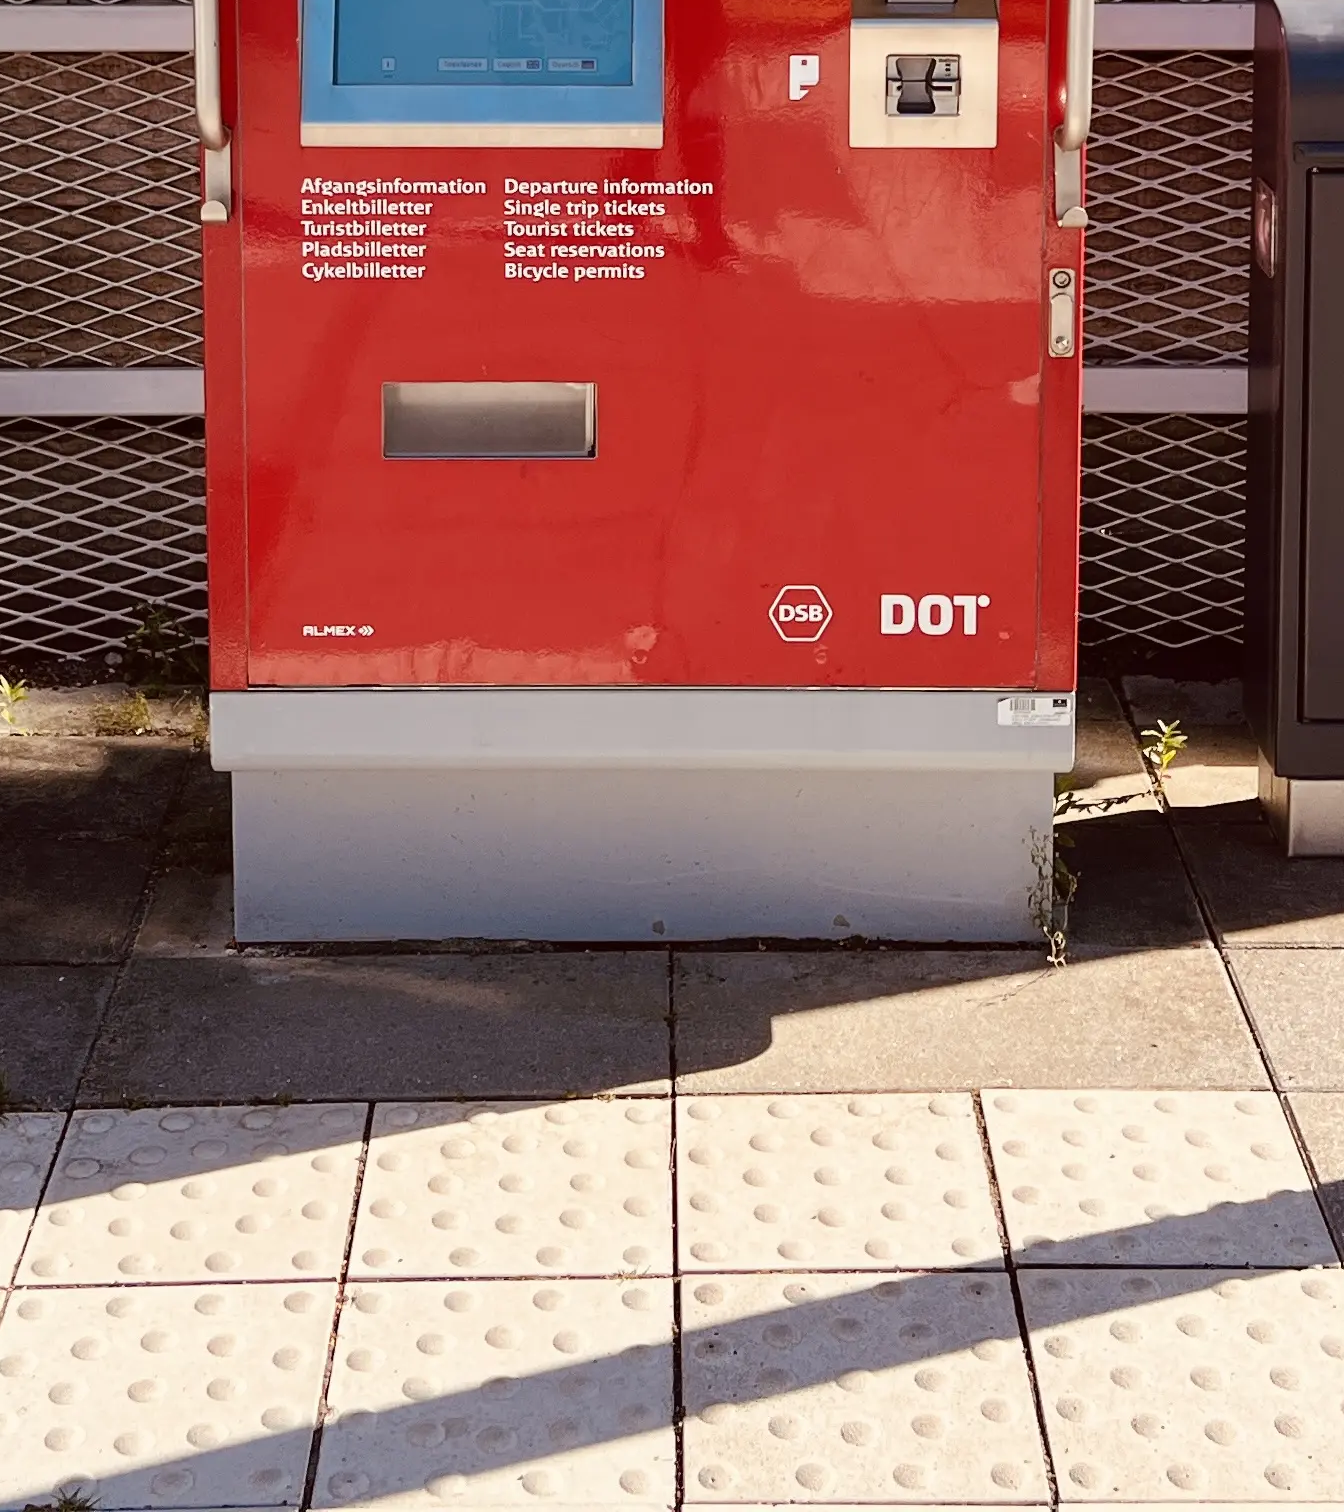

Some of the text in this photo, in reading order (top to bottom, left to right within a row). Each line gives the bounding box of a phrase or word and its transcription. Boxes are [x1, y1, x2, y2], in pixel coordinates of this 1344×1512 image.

[300, 177, 486, 197] Afgangsinformation
[504, 177, 713, 197] Departure information
[301, 198, 434, 216] Enkeltbilletter
[503, 199, 666, 218] Single trip tickets
[300, 219, 427, 237] Turistbilletter
[503, 220, 635, 237] Tourist tickets
[301, 240, 427, 258] Pladsbilletter
[503, 241, 665, 258] Seat reservations
[301, 261, 426, 281] Cykelbilletter
[504, 262, 645, 281] Bicycle permits
[778, 604, 824, 622] DSB
[880, 594, 990, 636] DOT
[302, 625, 356, 637] ALMEX
